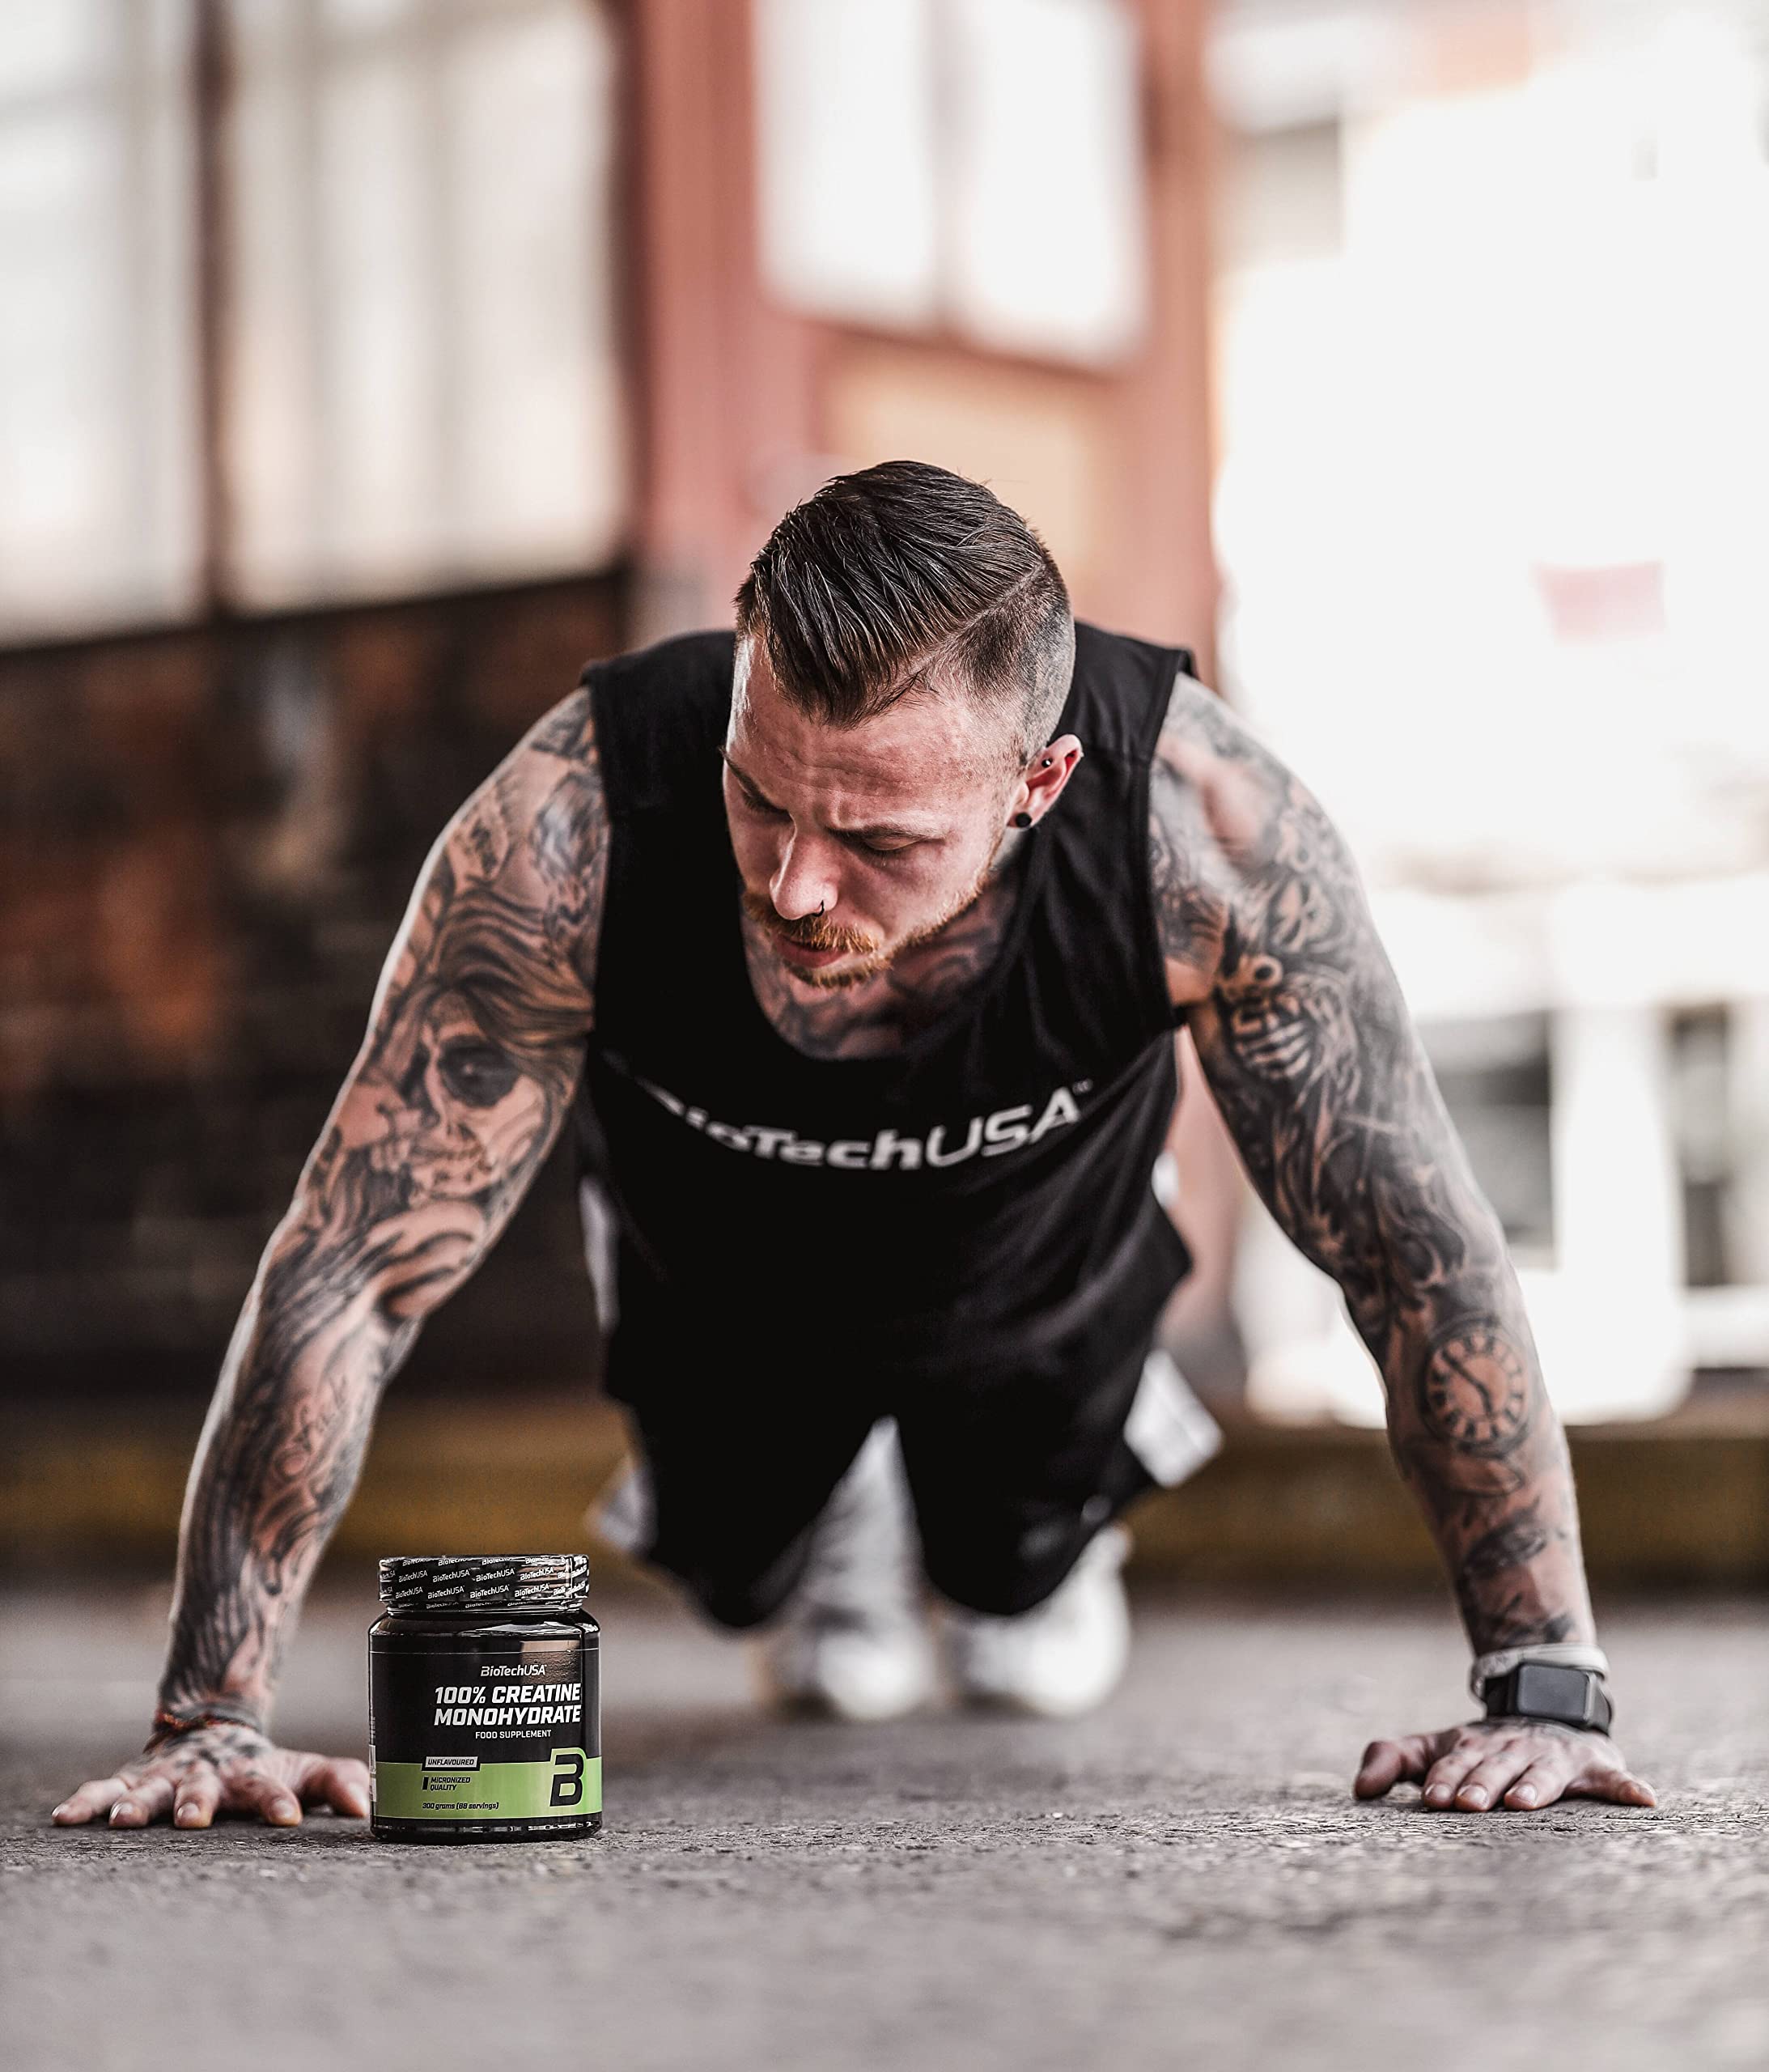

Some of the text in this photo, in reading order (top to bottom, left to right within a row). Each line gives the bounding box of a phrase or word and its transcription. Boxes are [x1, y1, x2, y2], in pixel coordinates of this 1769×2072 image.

[634, 1078, 1080, 1170] ioTechUSA
[398, 1569, 428, 1583] BioTechUSA
[432, 1569, 470, 1583] BioTechUSA
[475, 1568, 515, 1582] BioTechUSA
[520, 1566, 554, 1581] BioTechUSA
[395, 1586, 423, 1599] BioTechUSA
[427, 1586, 465, 1599] BioTechUSA
[469, 1584, 510, 1599] BioTechUSA
[514, 1583, 549, 1598] BioTechUSA
[480, 1664, 547, 1678] BioTechUSA
[435, 1683, 582, 1705] 100% CREATINE
[434, 1704, 582, 1726] MONOHYDRATE
[475, 1729, 552, 1739] FOOD SUPPLEMENT
[427, 1758, 475, 1766] UNFLAVOURED
[456, 1802, 468, 1811] (88
[468, 1802, 499, 1811] servings)
